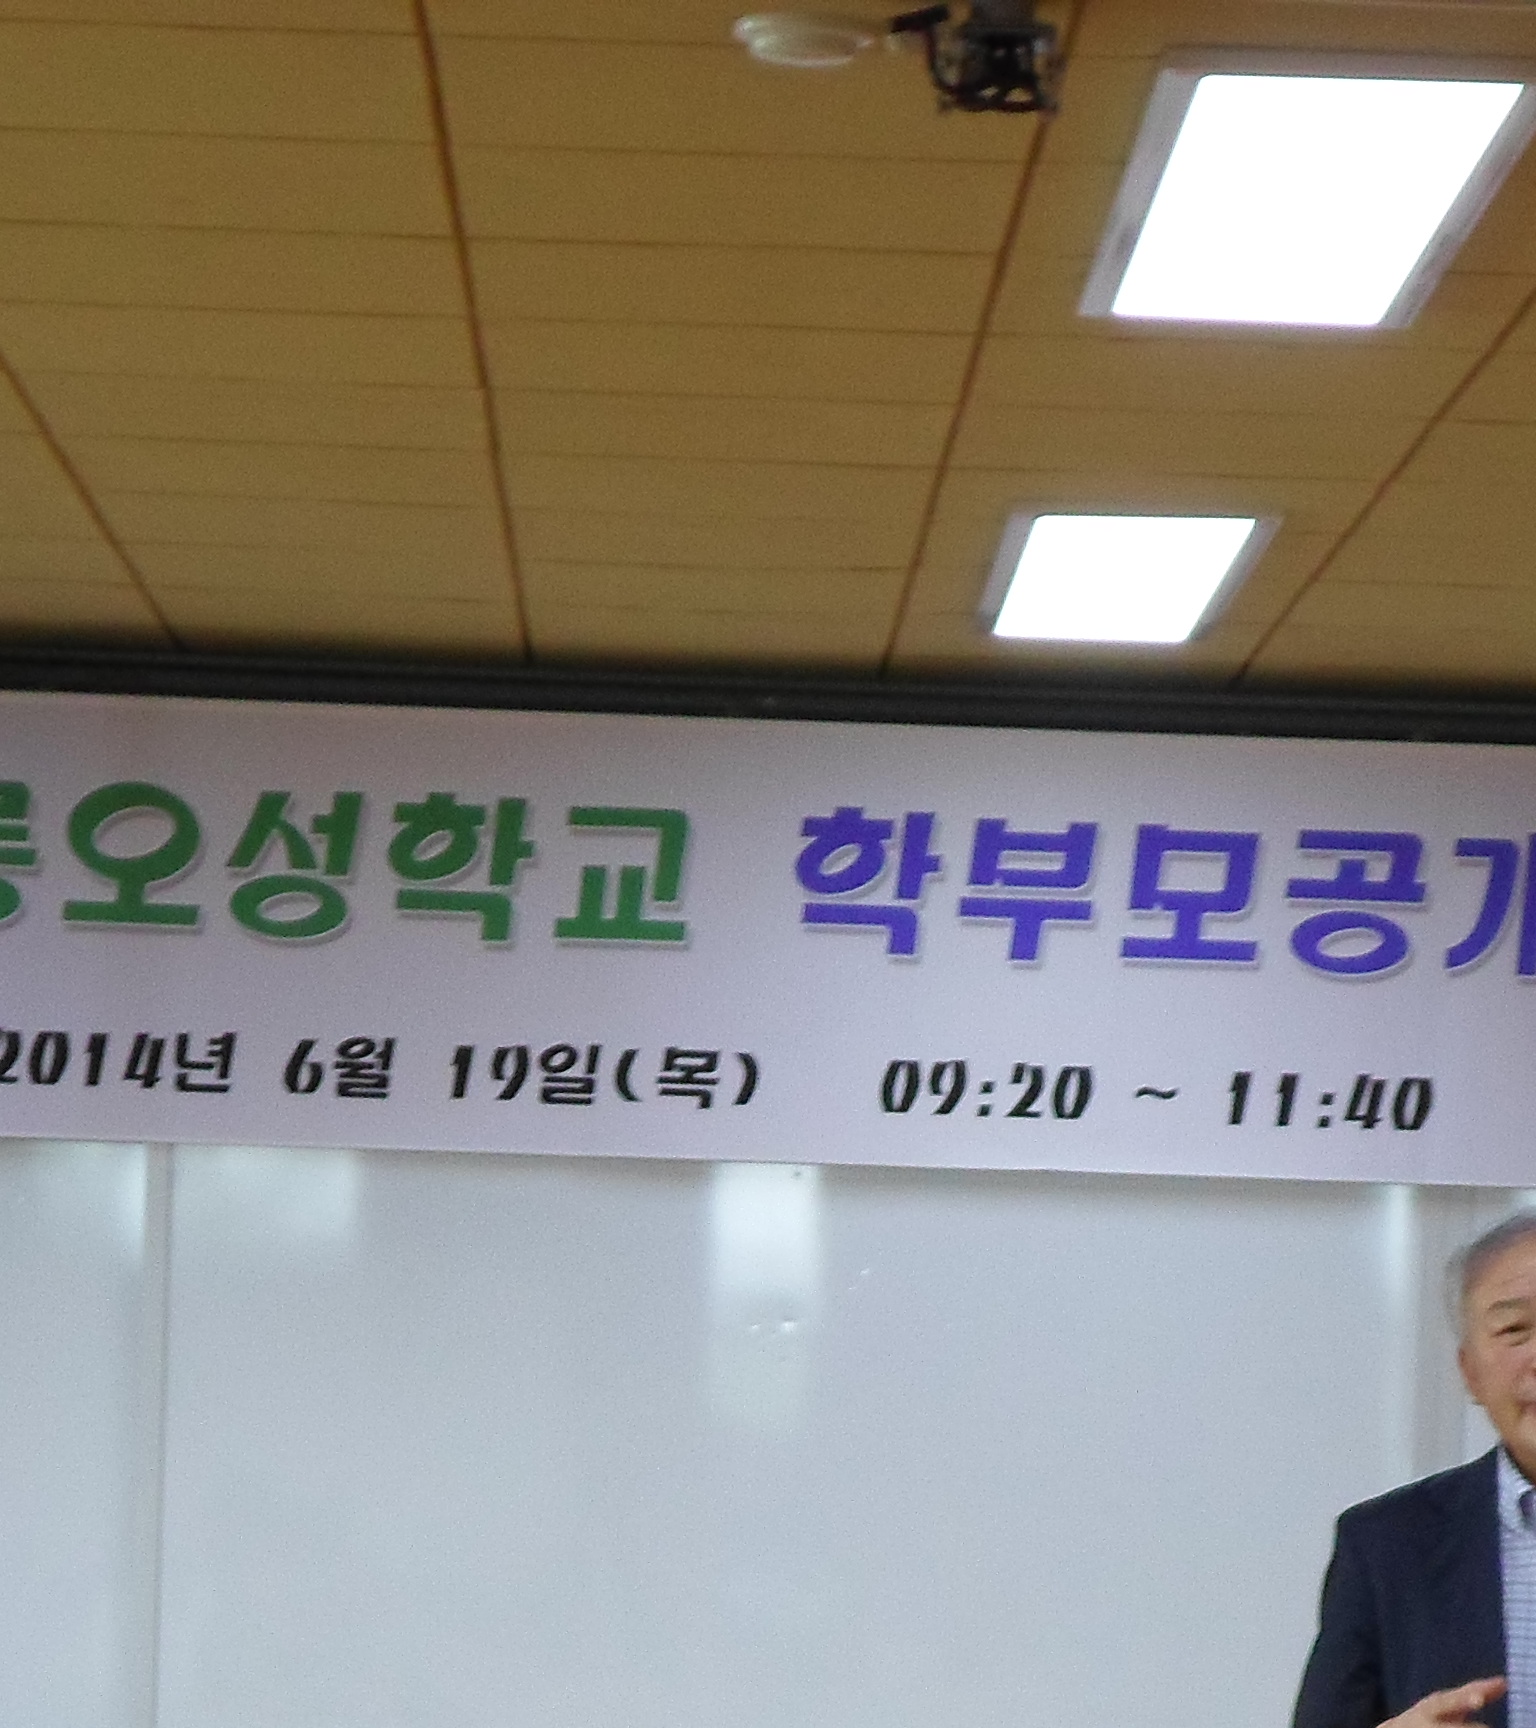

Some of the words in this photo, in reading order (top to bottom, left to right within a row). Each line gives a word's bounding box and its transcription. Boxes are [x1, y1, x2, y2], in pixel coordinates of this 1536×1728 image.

[283, 1036, 397, 1099] 6월
[449, 1043, 760, 1109] 19일(목)
[880, 1059, 1093, 1119] 09:20
[1226, 1070, 1434, 1131] 11:40
